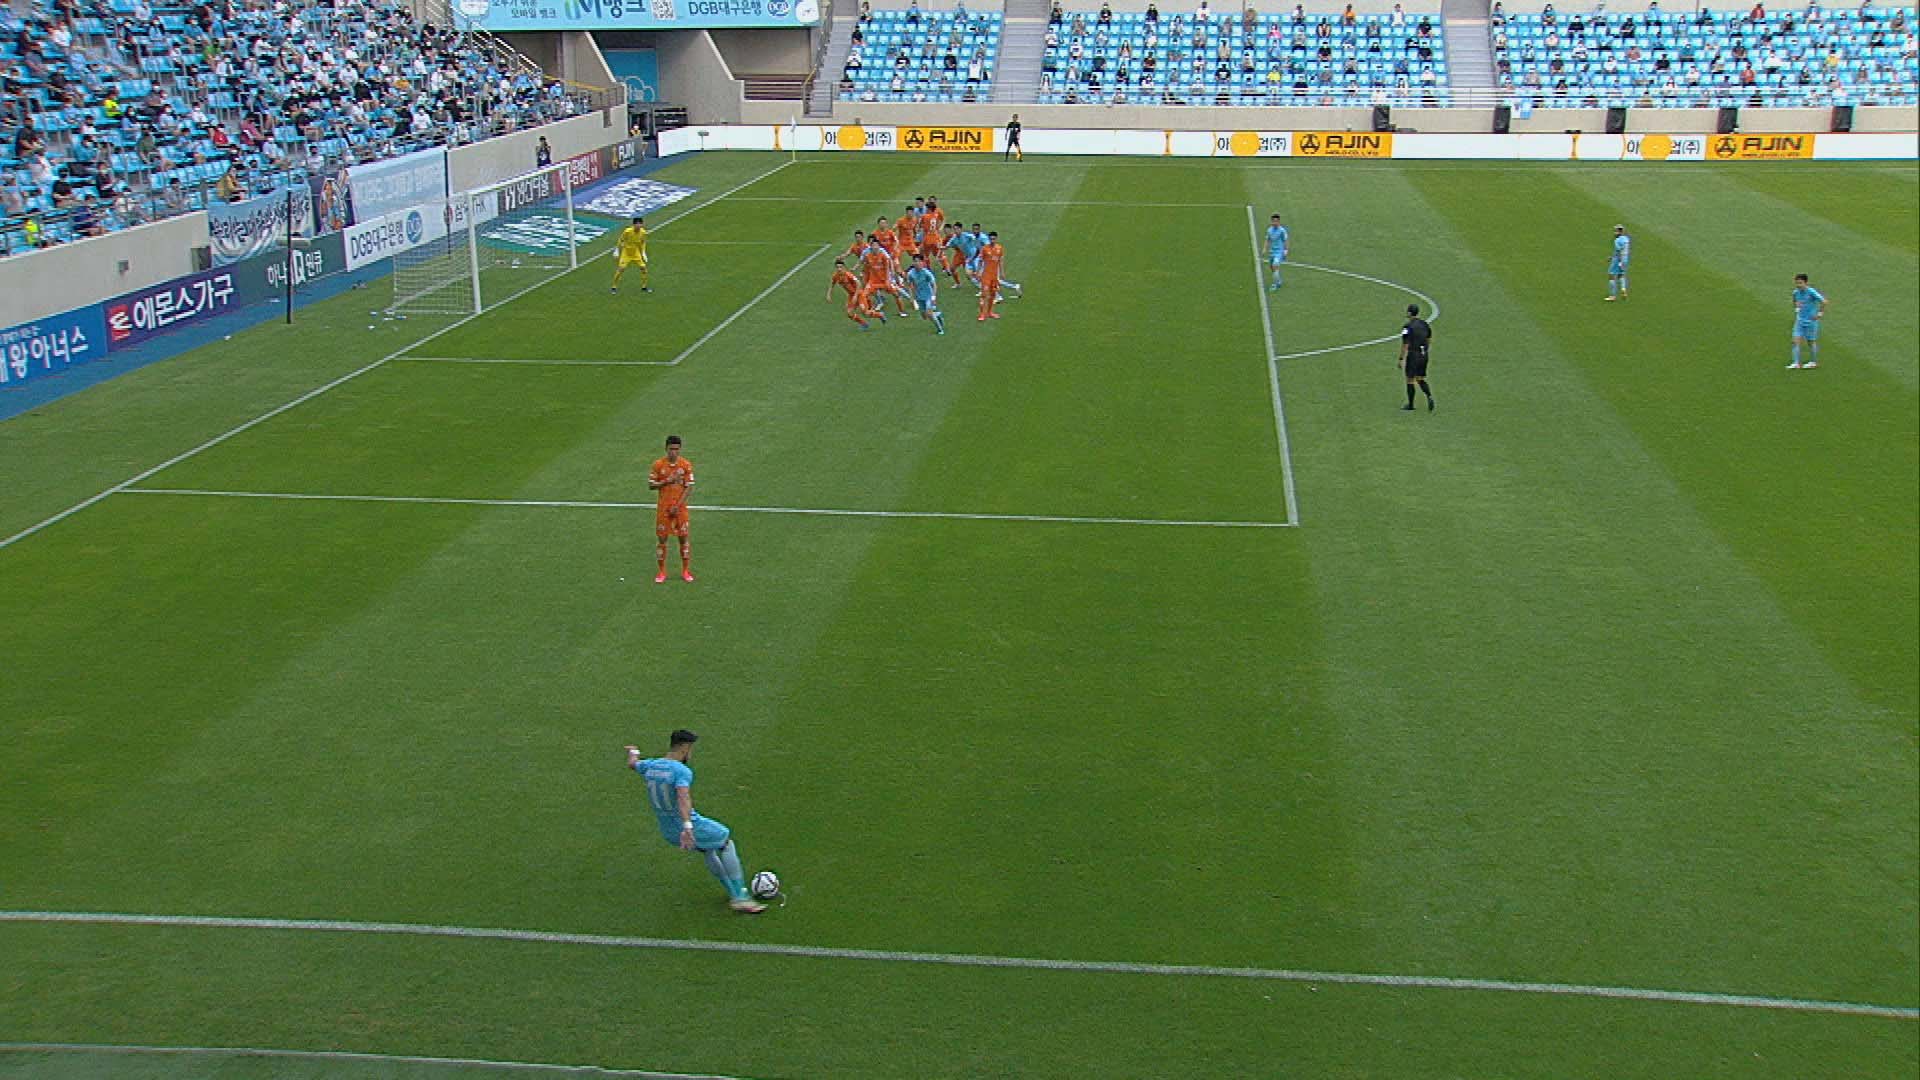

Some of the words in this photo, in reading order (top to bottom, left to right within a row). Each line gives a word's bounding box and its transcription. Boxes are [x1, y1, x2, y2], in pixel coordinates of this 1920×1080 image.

[689, 1, 762, 16] DGB대구은행
[929, 130, 981, 144] AJIN
[1326, 135, 1380, 148] AJIN
[1743, 137, 1802, 150] AJIN
[351, 219, 404, 259] DGB대구은행
[133, 273, 234, 330] 에몬스가구
